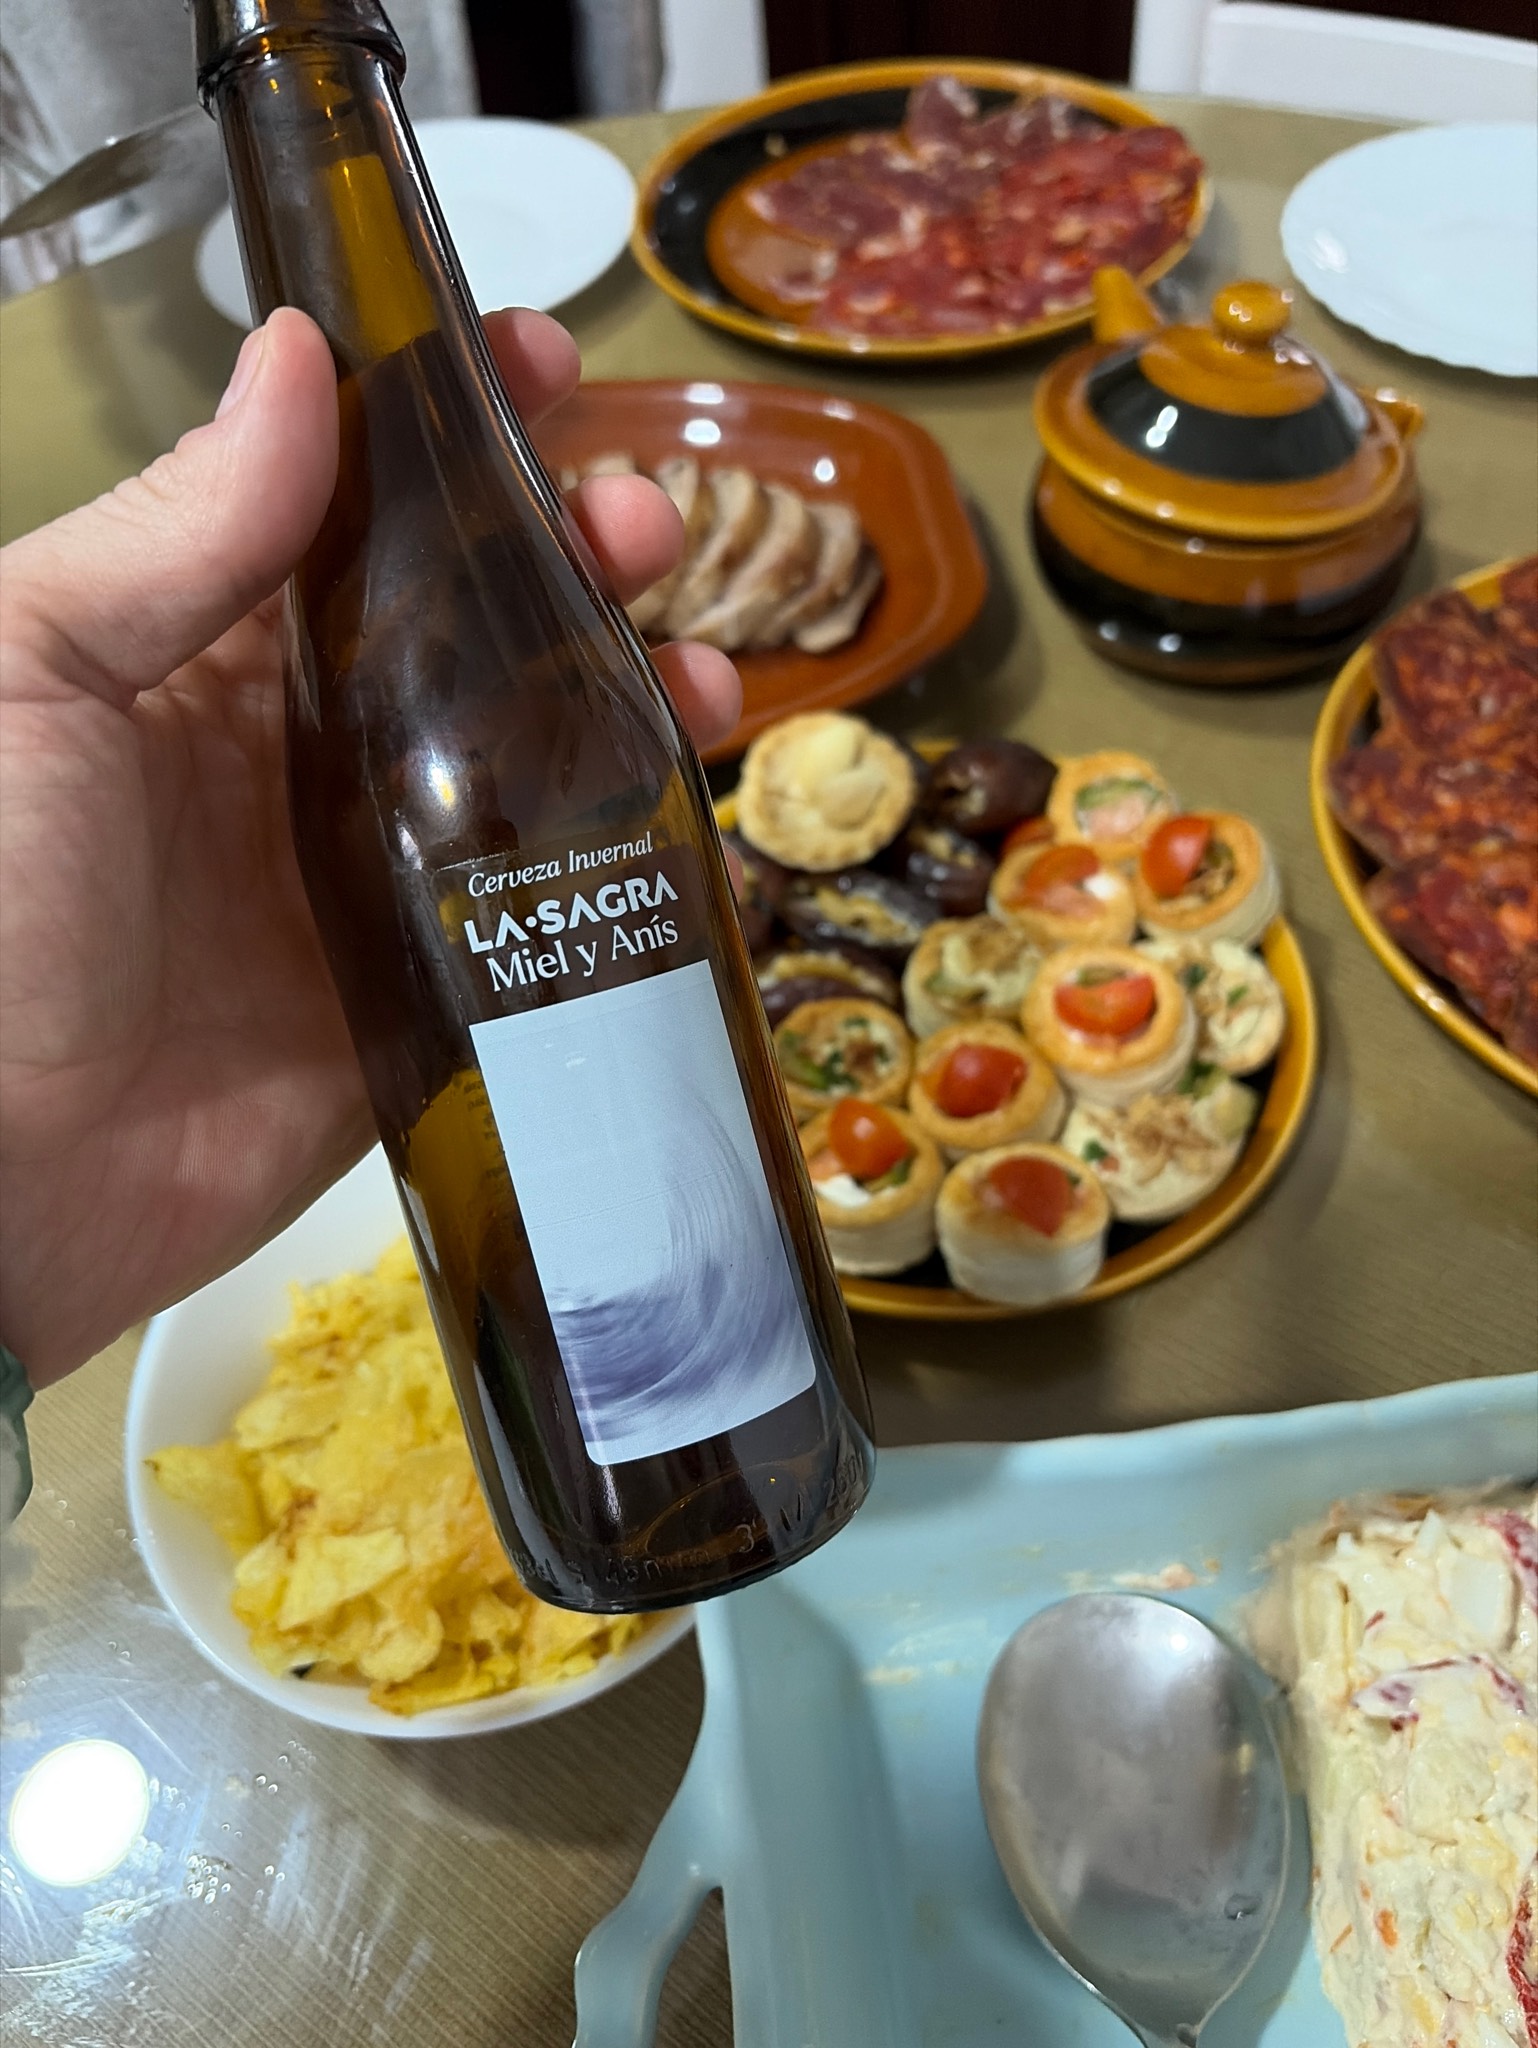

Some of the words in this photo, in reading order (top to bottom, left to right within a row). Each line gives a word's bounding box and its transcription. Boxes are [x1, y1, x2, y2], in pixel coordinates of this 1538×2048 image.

[468, 858, 562, 897] Cerveza
[568, 831, 653, 874] Invernal
[486, 939, 570, 992] Miel
[575, 941, 598, 977] y
[611, 914, 679, 961] Anís
